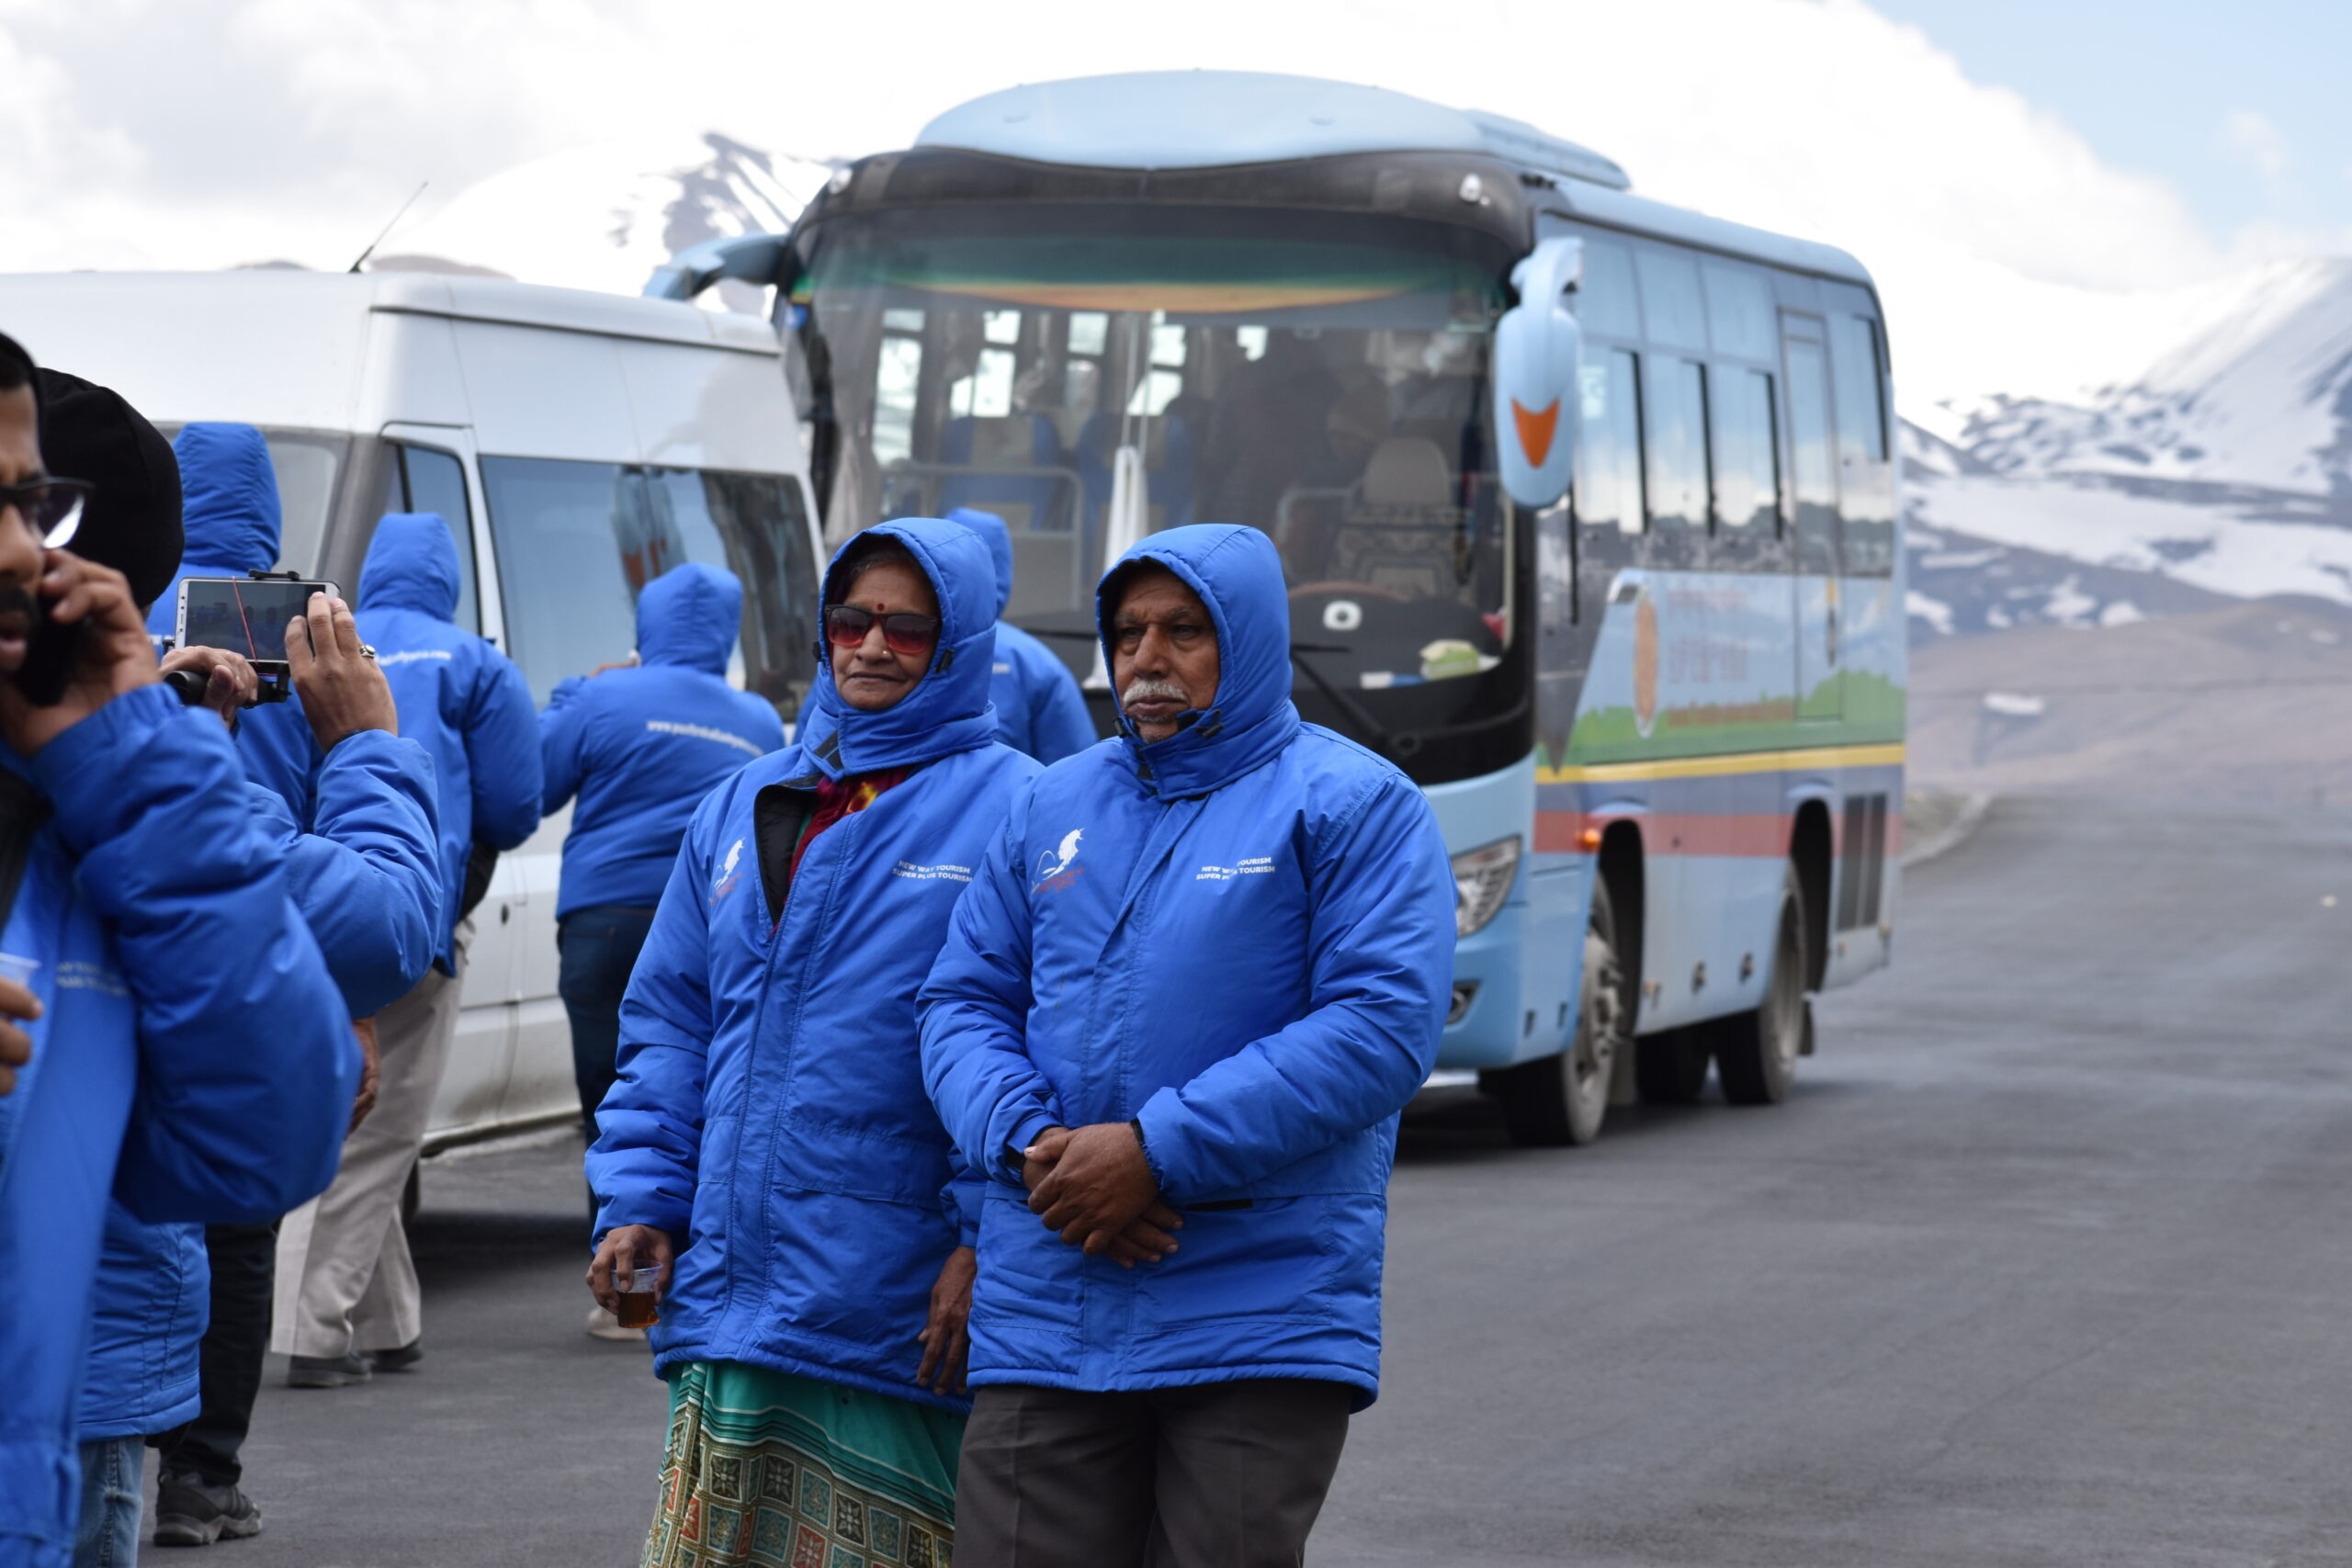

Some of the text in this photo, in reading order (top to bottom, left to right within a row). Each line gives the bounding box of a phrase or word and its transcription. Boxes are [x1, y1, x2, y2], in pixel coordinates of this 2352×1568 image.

[892, 867, 917, 879] SUPER
[937, 872, 973, 882] TOURISM
[899, 861, 917, 871] NEW
[935, 864, 971, 874] TOURISM
